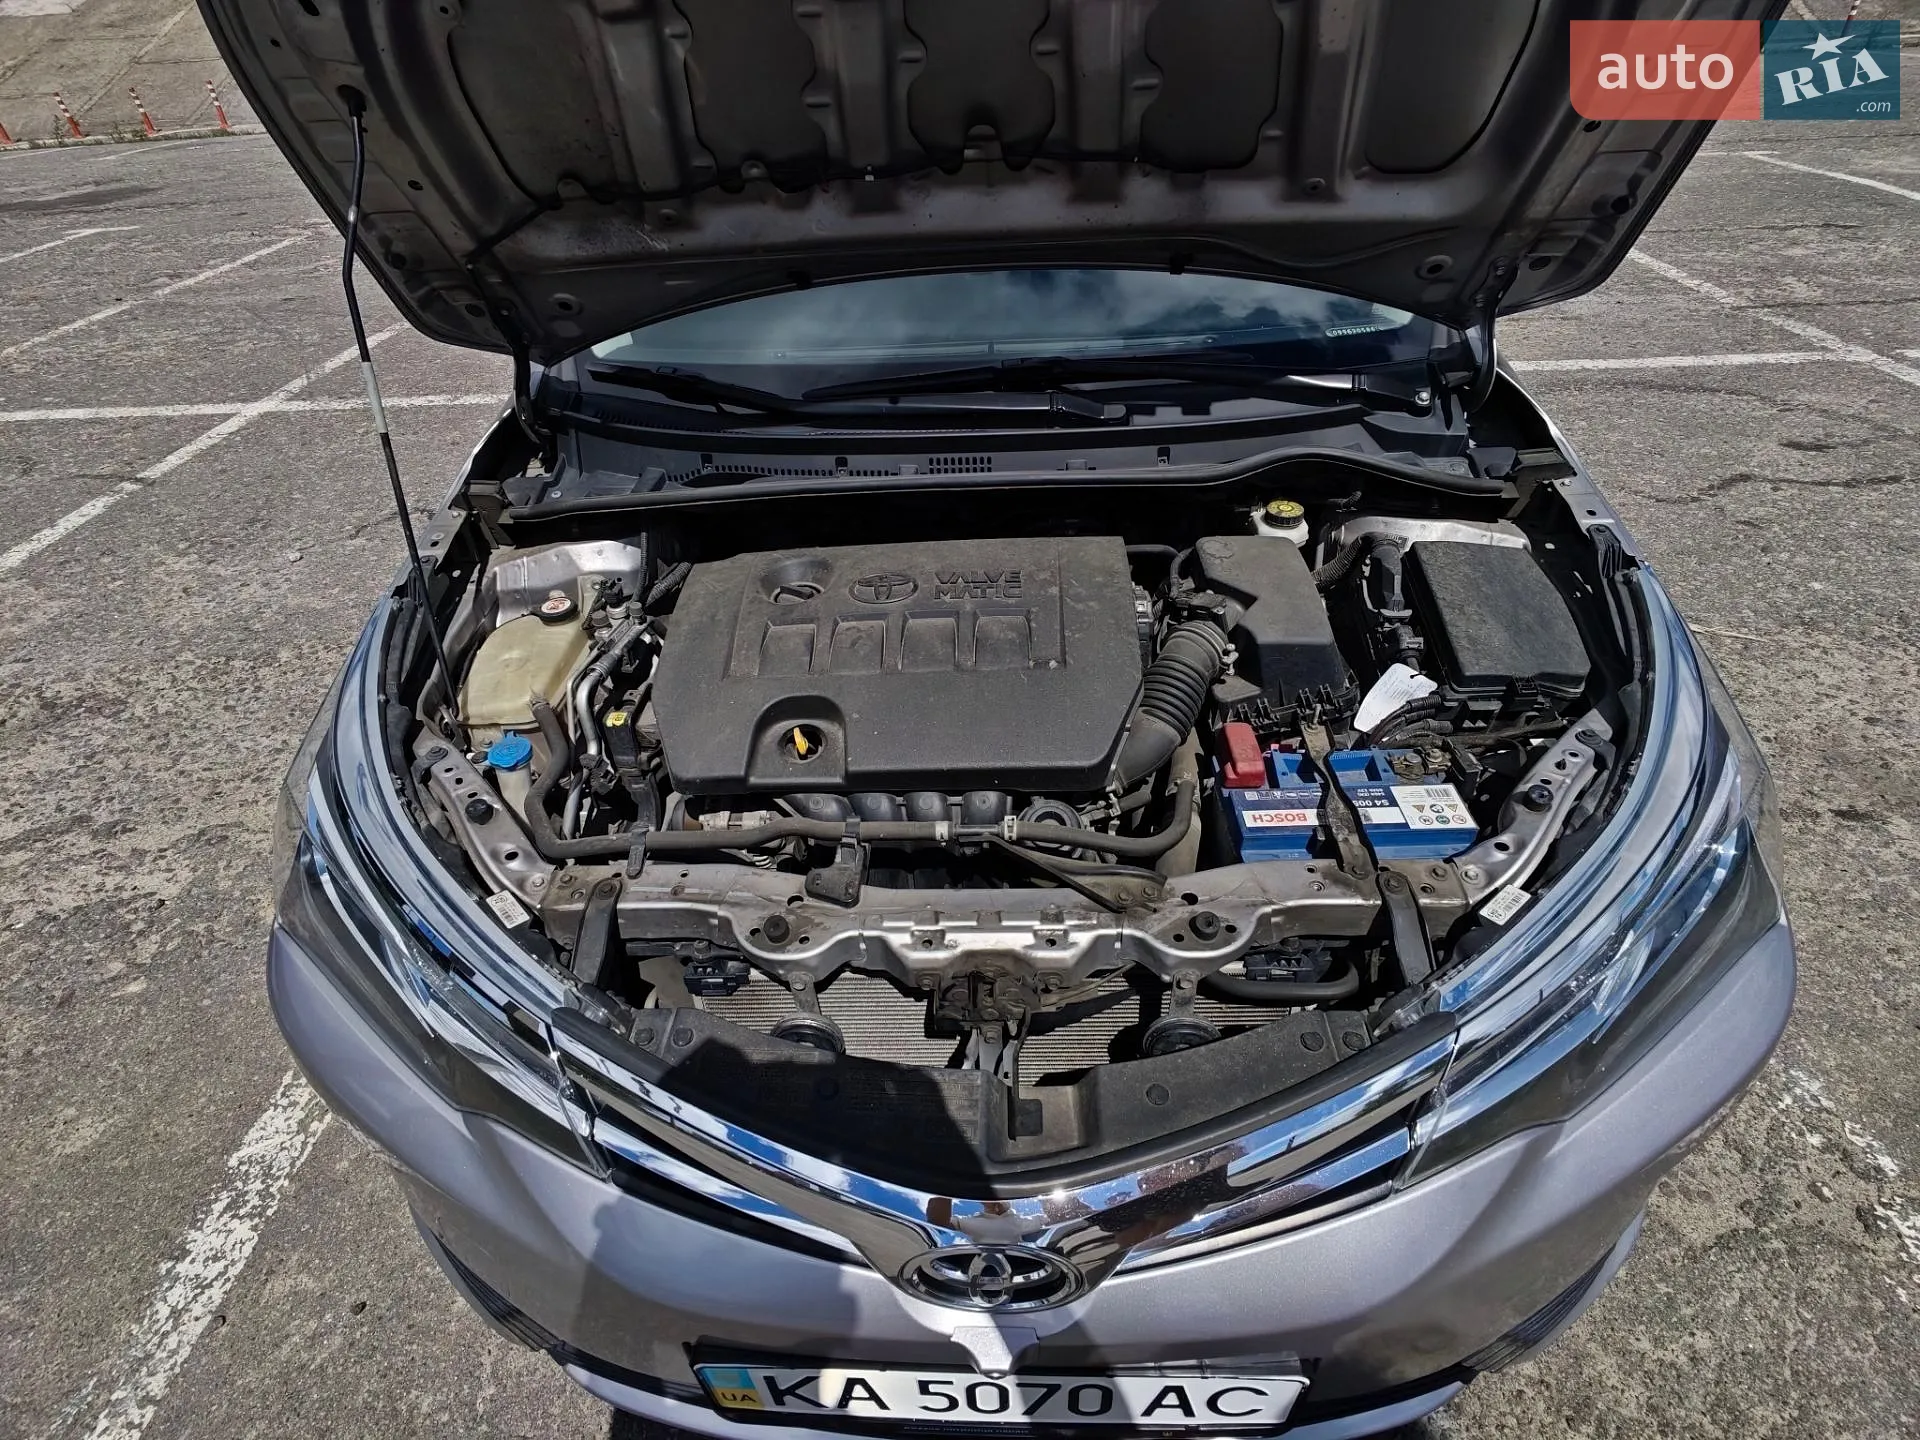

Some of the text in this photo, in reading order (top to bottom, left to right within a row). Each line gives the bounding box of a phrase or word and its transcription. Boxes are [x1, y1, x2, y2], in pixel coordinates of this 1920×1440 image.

[934, 568, 1023, 584] VALVE
[933, 584, 1023, 600] MATIC
[1252, 812, 1308, 823] BOSCH
[721, 1392, 757, 1403] UA
[762, 1375, 1270, 1418] KA 5070 AC
